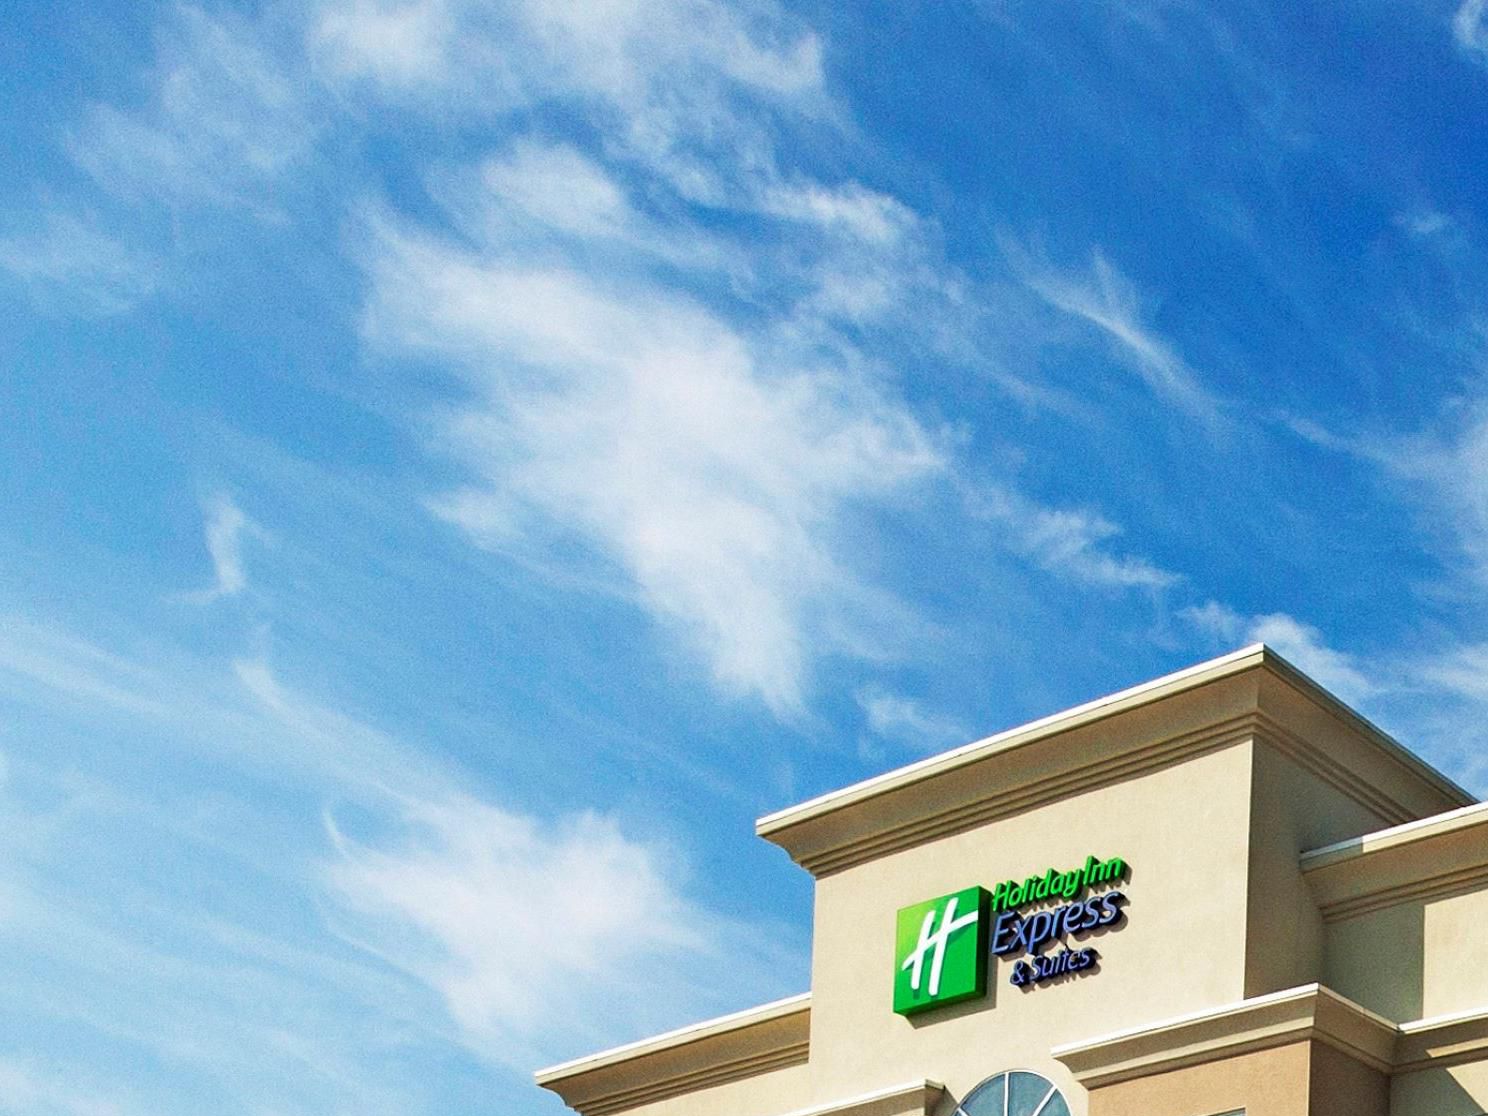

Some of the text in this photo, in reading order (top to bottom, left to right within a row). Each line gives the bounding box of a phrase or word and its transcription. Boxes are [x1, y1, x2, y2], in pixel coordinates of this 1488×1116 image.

[992, 855, 1125, 912] Holiday Inn
[991, 890, 1121, 954] Express
[1009, 949, 1095, 986] & Suites
